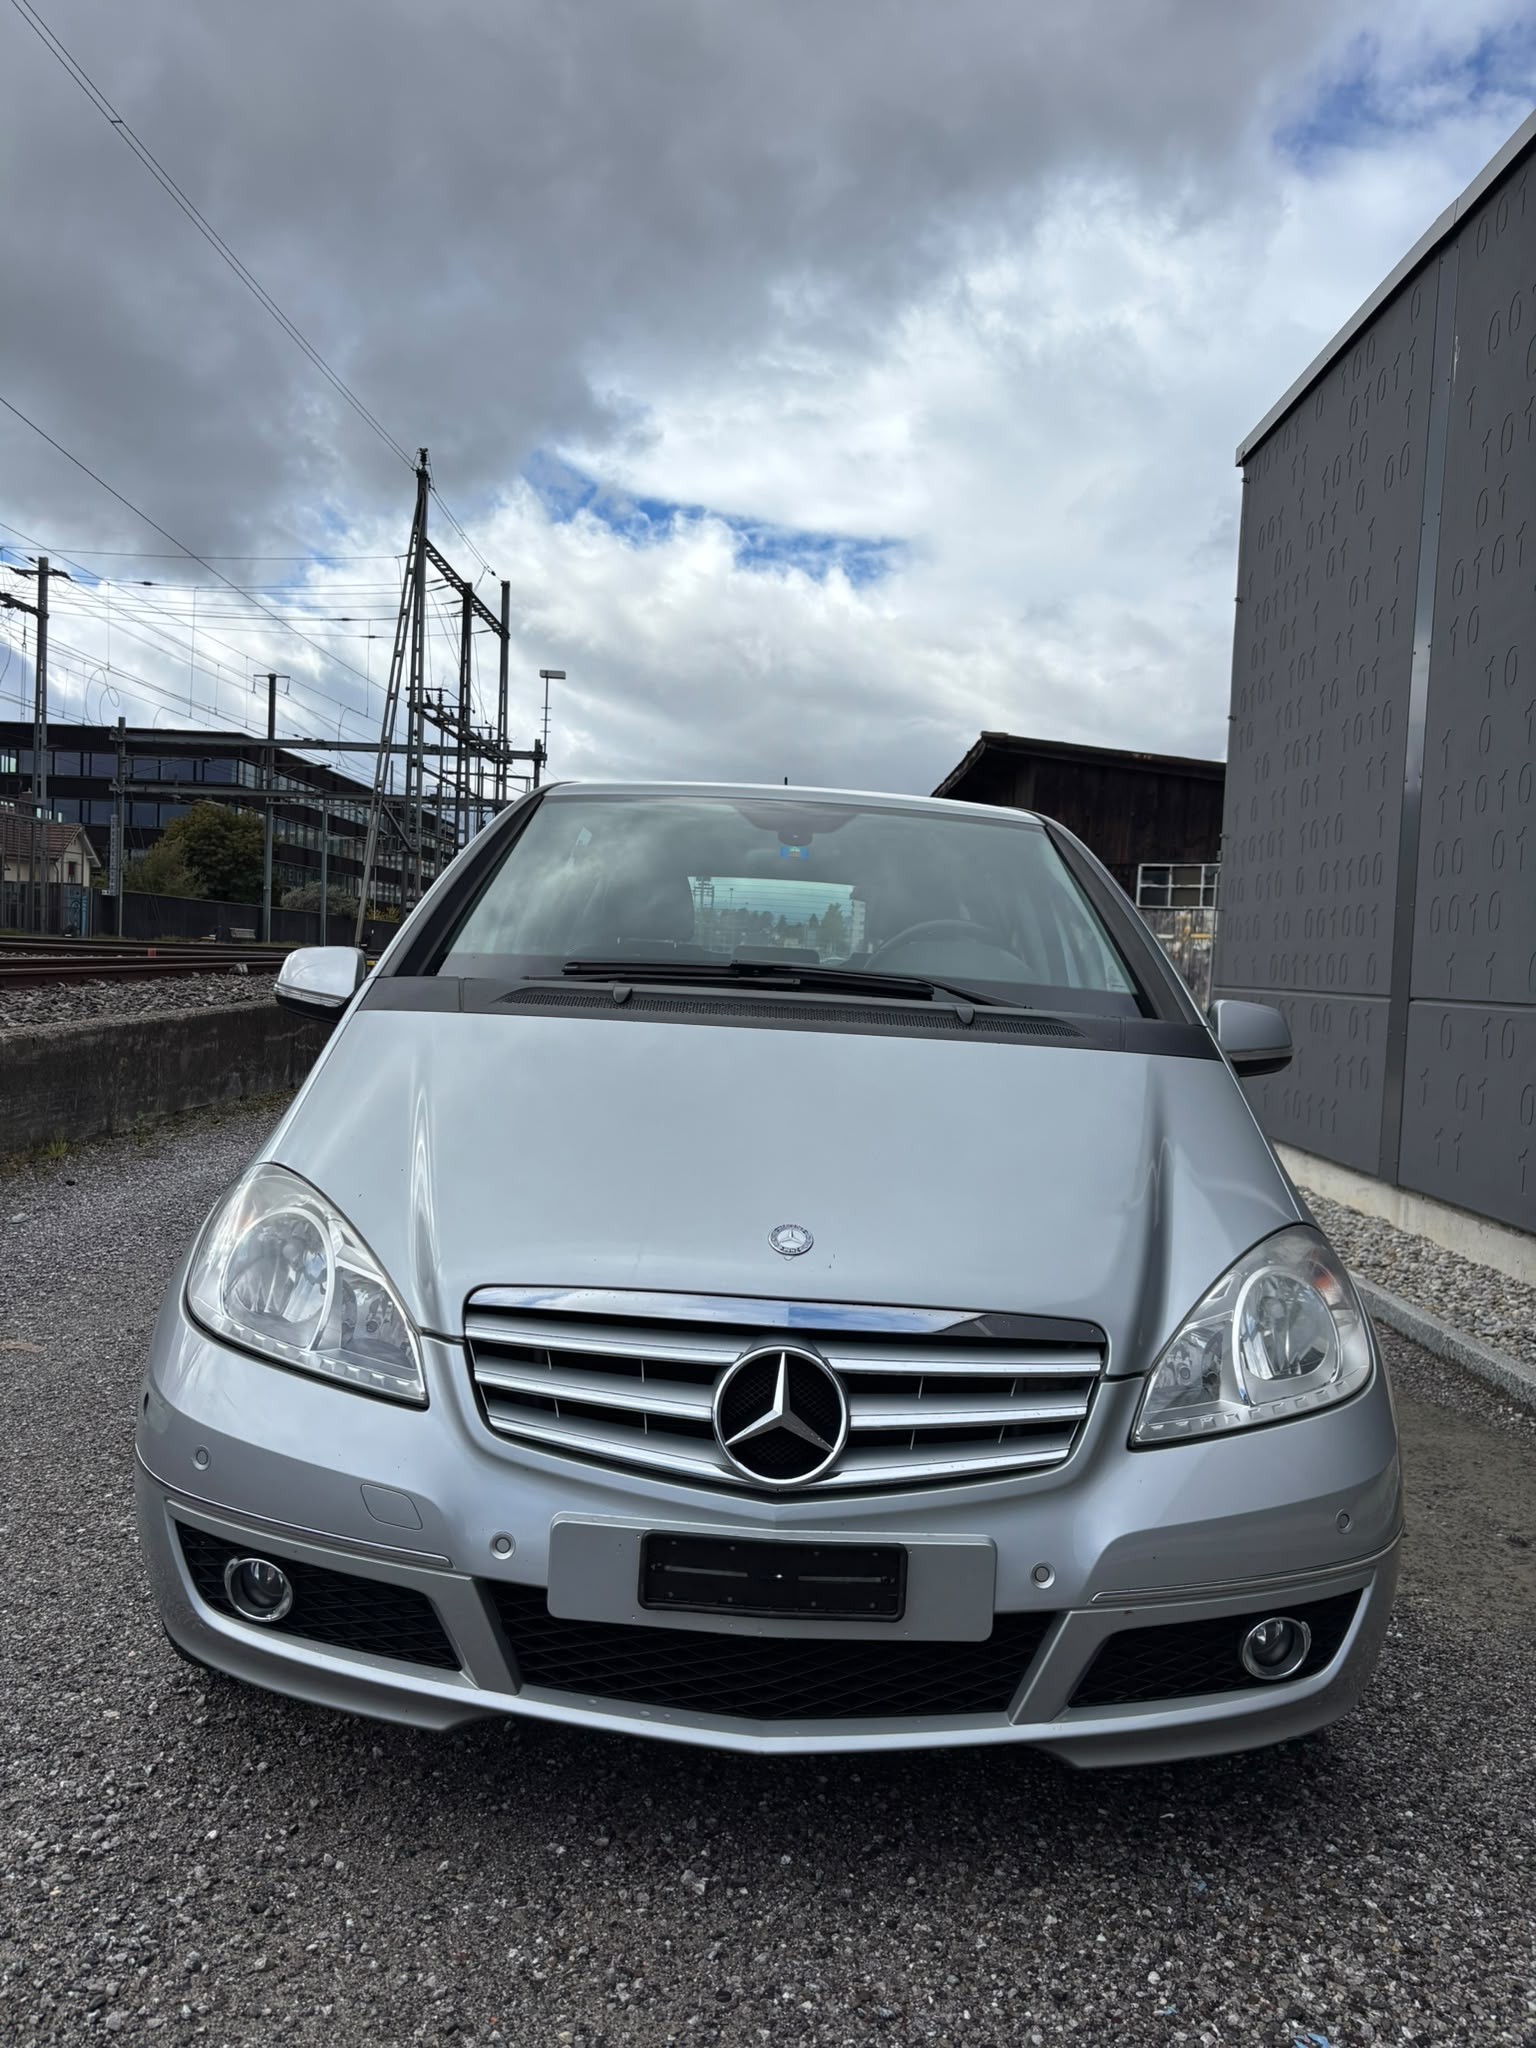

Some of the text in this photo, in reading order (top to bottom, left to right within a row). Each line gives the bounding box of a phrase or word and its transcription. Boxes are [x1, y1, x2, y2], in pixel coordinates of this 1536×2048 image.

[1477, 169, 1528, 261] 001
[1482, 394, 1536, 473] 101
[1476, 472, 1509, 532] 01
[1452, 520, 1527, 601] 0101
[1450, 604, 1480, 657] 10
[1484, 644, 1519, 700] 10
[1432, 825, 1528, 881] 00 01
[1430, 889, 1501, 937] 0010
[1481, 1015, 1516, 1062] 10
[1455, 1071, 1489, 1121] 01
[1433, 1126, 1463, 1174] 11
